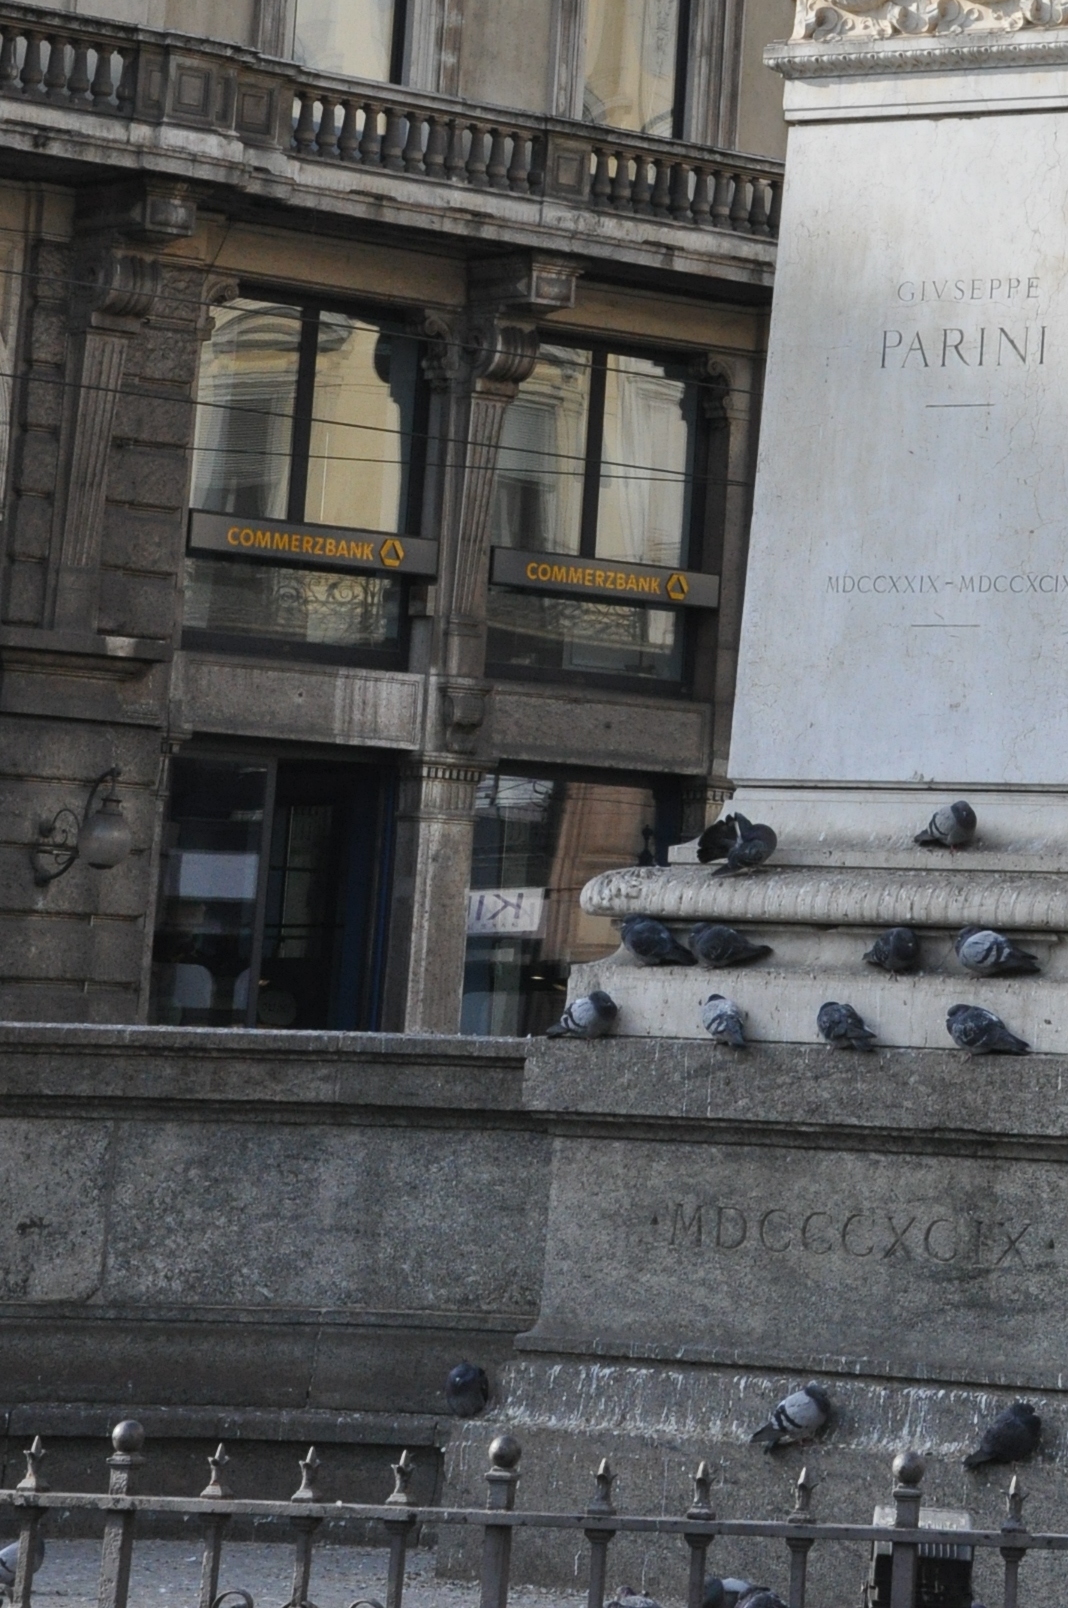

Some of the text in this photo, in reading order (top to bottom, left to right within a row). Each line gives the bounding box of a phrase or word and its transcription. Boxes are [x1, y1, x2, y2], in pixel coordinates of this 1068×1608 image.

[897, 276, 1041, 302] GIVSEPPE
[880, 325, 1048, 369] PARINI
[227, 526, 374, 561] COMMERZBANK
[526, 562, 661, 594] COMMERZBANK
[826, 574, 940, 593] MDCCXXIX
[667, 1202, 1032, 1270] MDCCCXCIX
